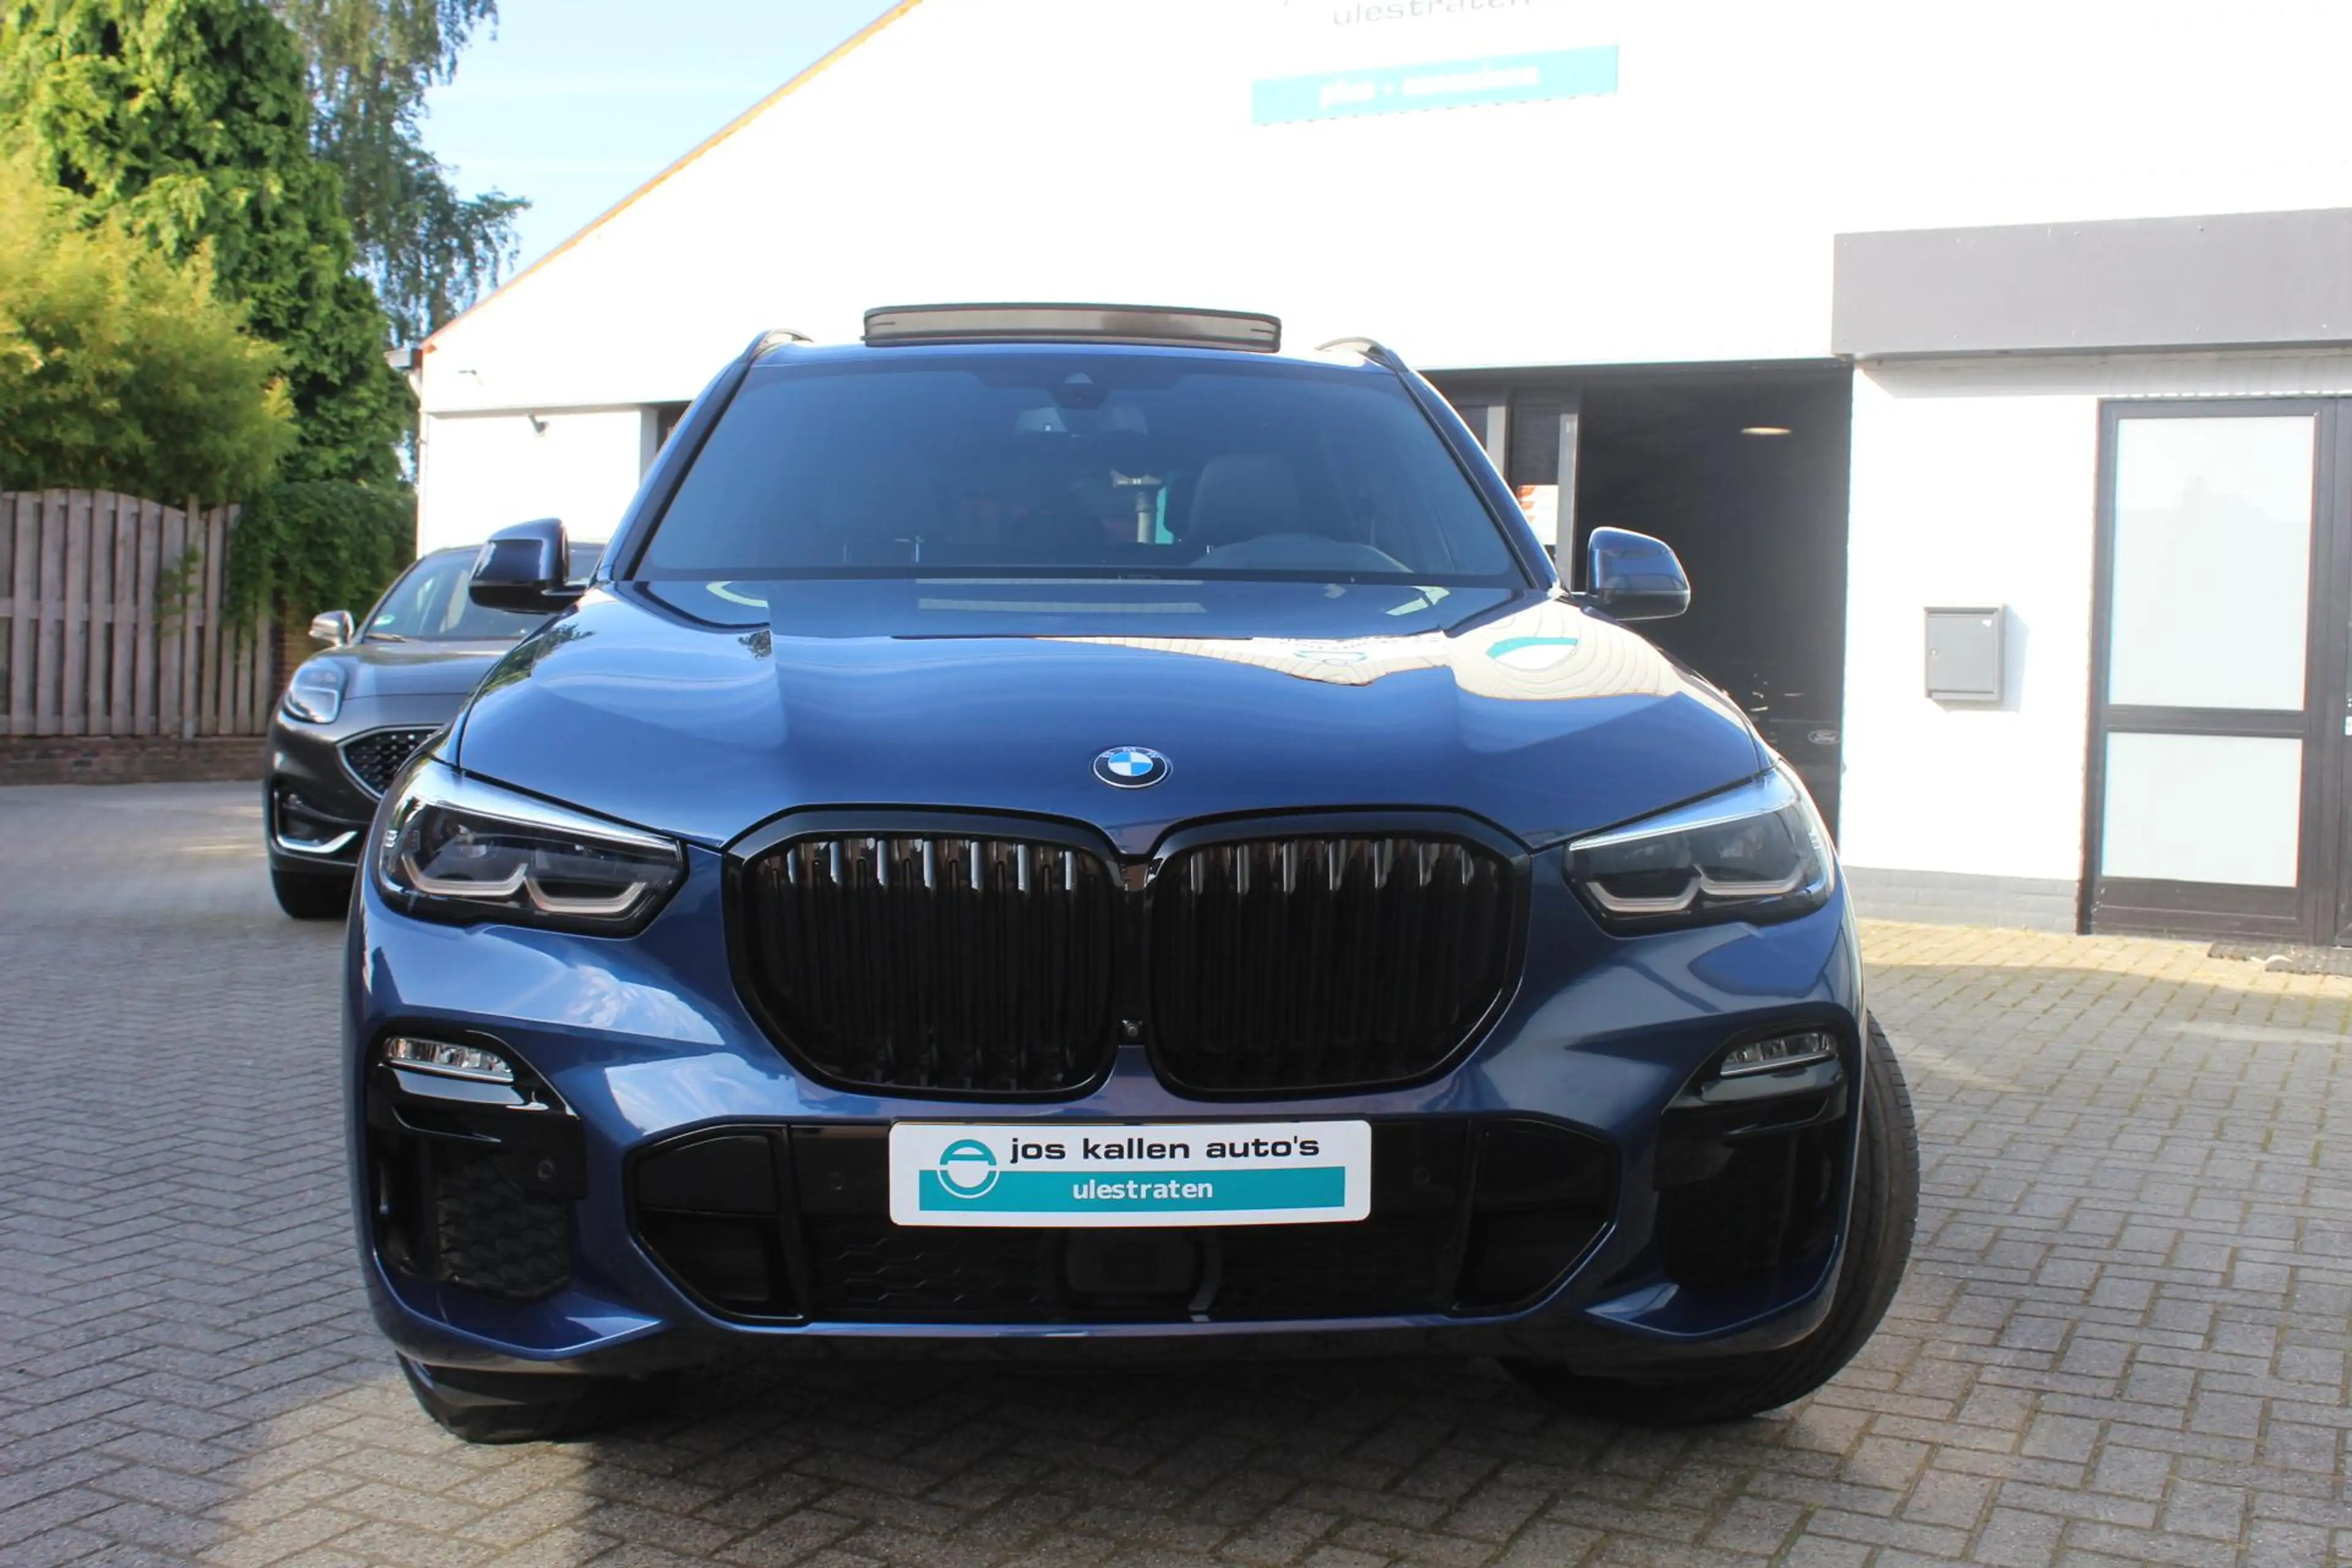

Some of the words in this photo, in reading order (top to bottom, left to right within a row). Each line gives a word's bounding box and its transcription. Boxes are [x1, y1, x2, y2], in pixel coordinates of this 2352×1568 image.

[1010, 1137, 1066, 1164] jos
[1082, 1137, 1190, 1159] kallen
[1206, 1136, 1320, 1159] auto's
[1072, 1178, 1213, 1200] ulestraten
